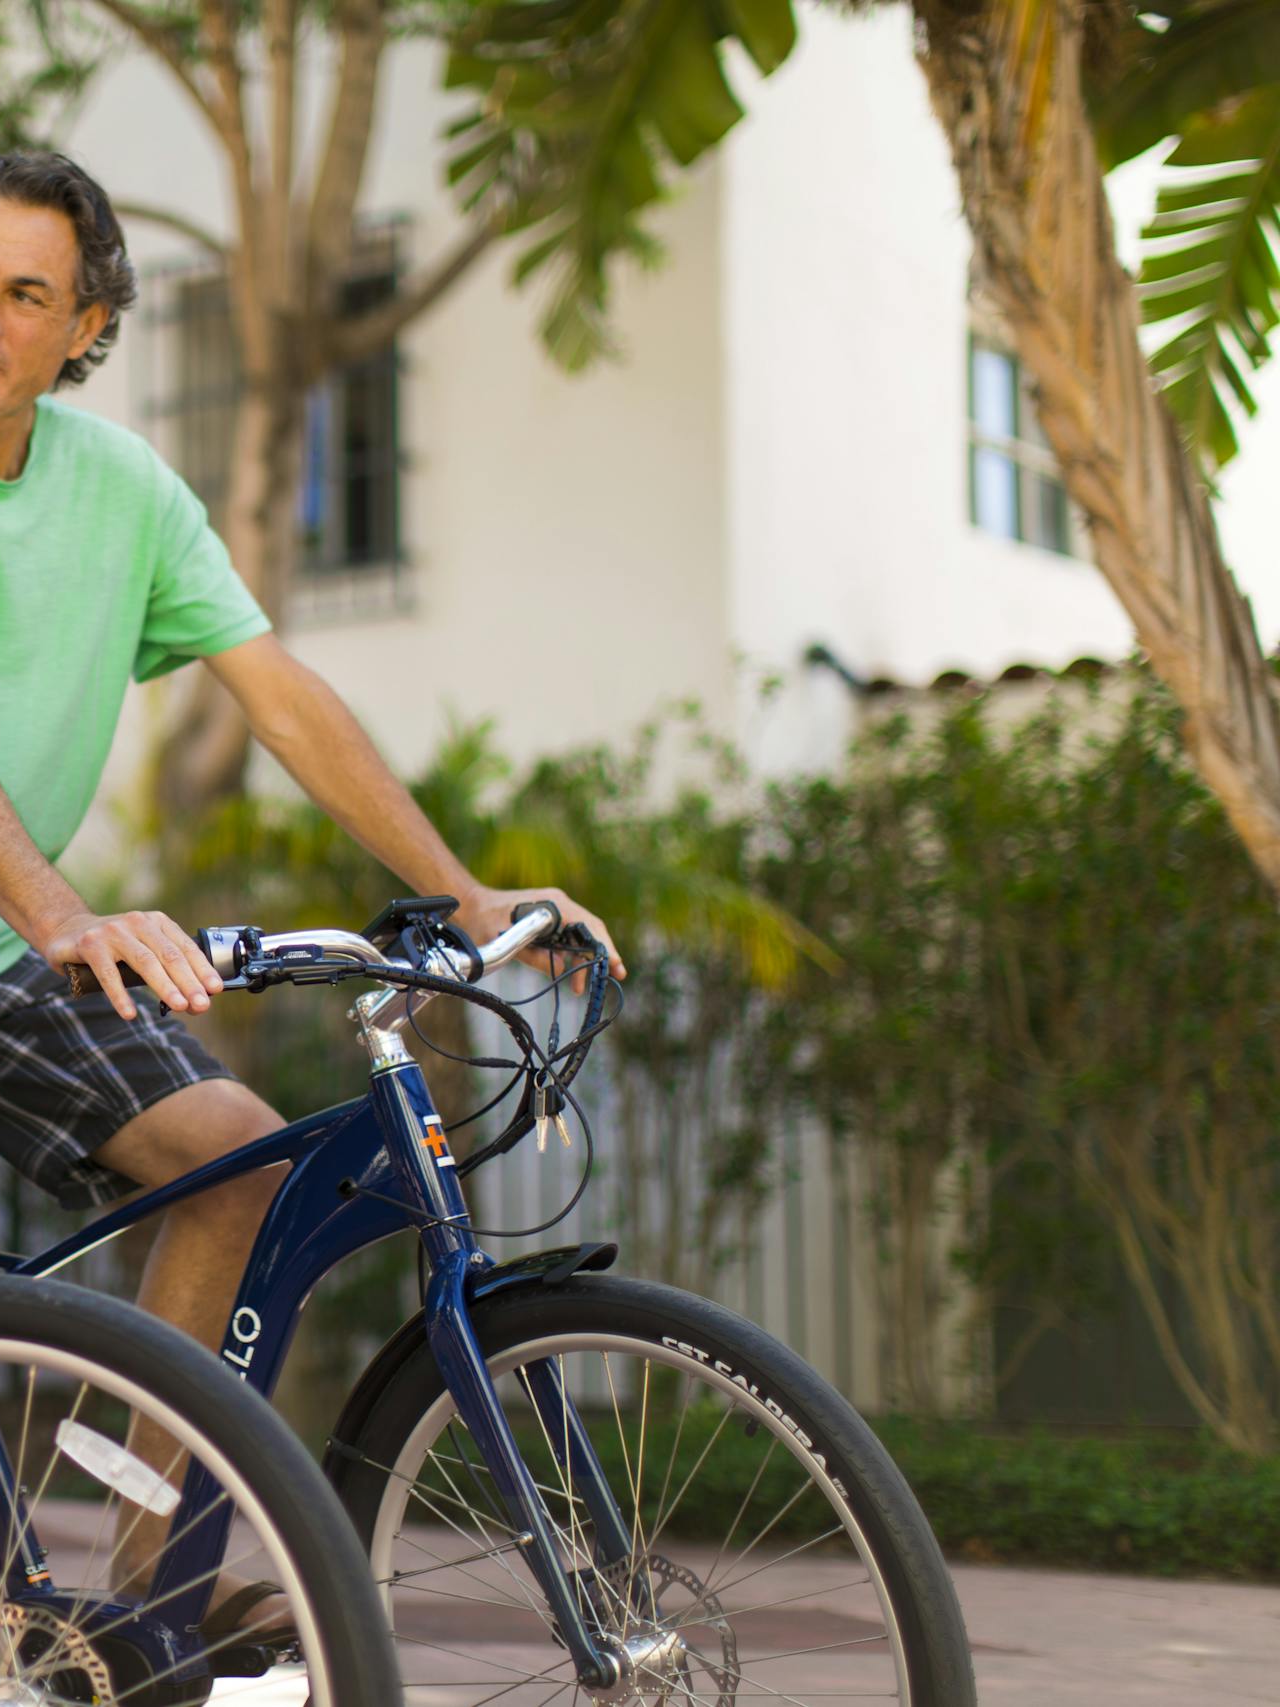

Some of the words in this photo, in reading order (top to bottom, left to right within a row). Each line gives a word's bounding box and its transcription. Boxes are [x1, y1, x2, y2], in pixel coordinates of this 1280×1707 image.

[223, 1306, 262, 1382] LO
[662, 1336, 709, 1363] CST
[714, 1360, 827, 1472] CALDERA
